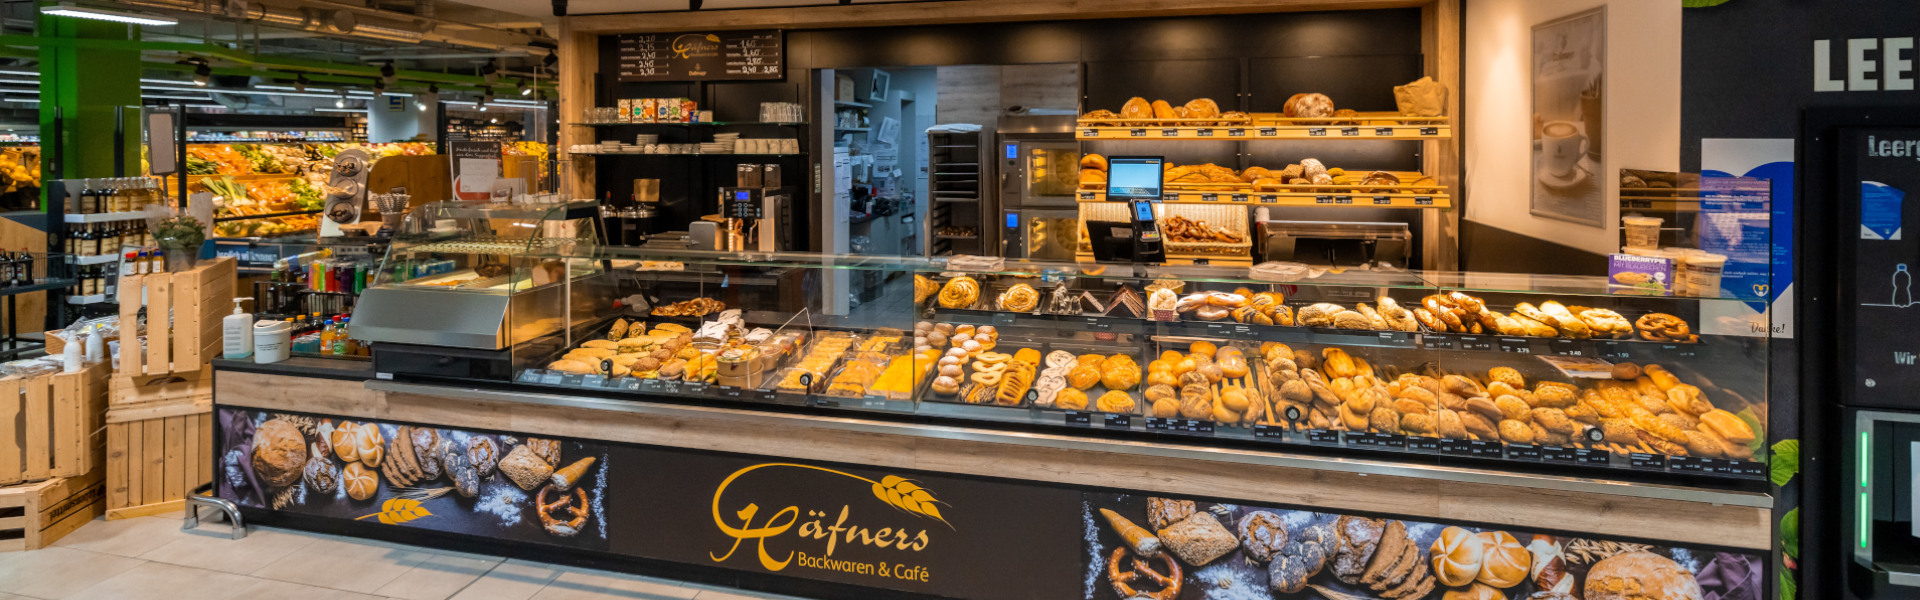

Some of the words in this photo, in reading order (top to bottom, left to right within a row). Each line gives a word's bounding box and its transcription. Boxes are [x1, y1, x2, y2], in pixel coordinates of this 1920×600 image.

[1894, 351, 1917, 365] Wir
[710, 463, 929, 572] Häfners
[798, 552, 875, 576] Backwaren
[878, 561, 891, 578] &
[894, 563, 930, 583] Café
